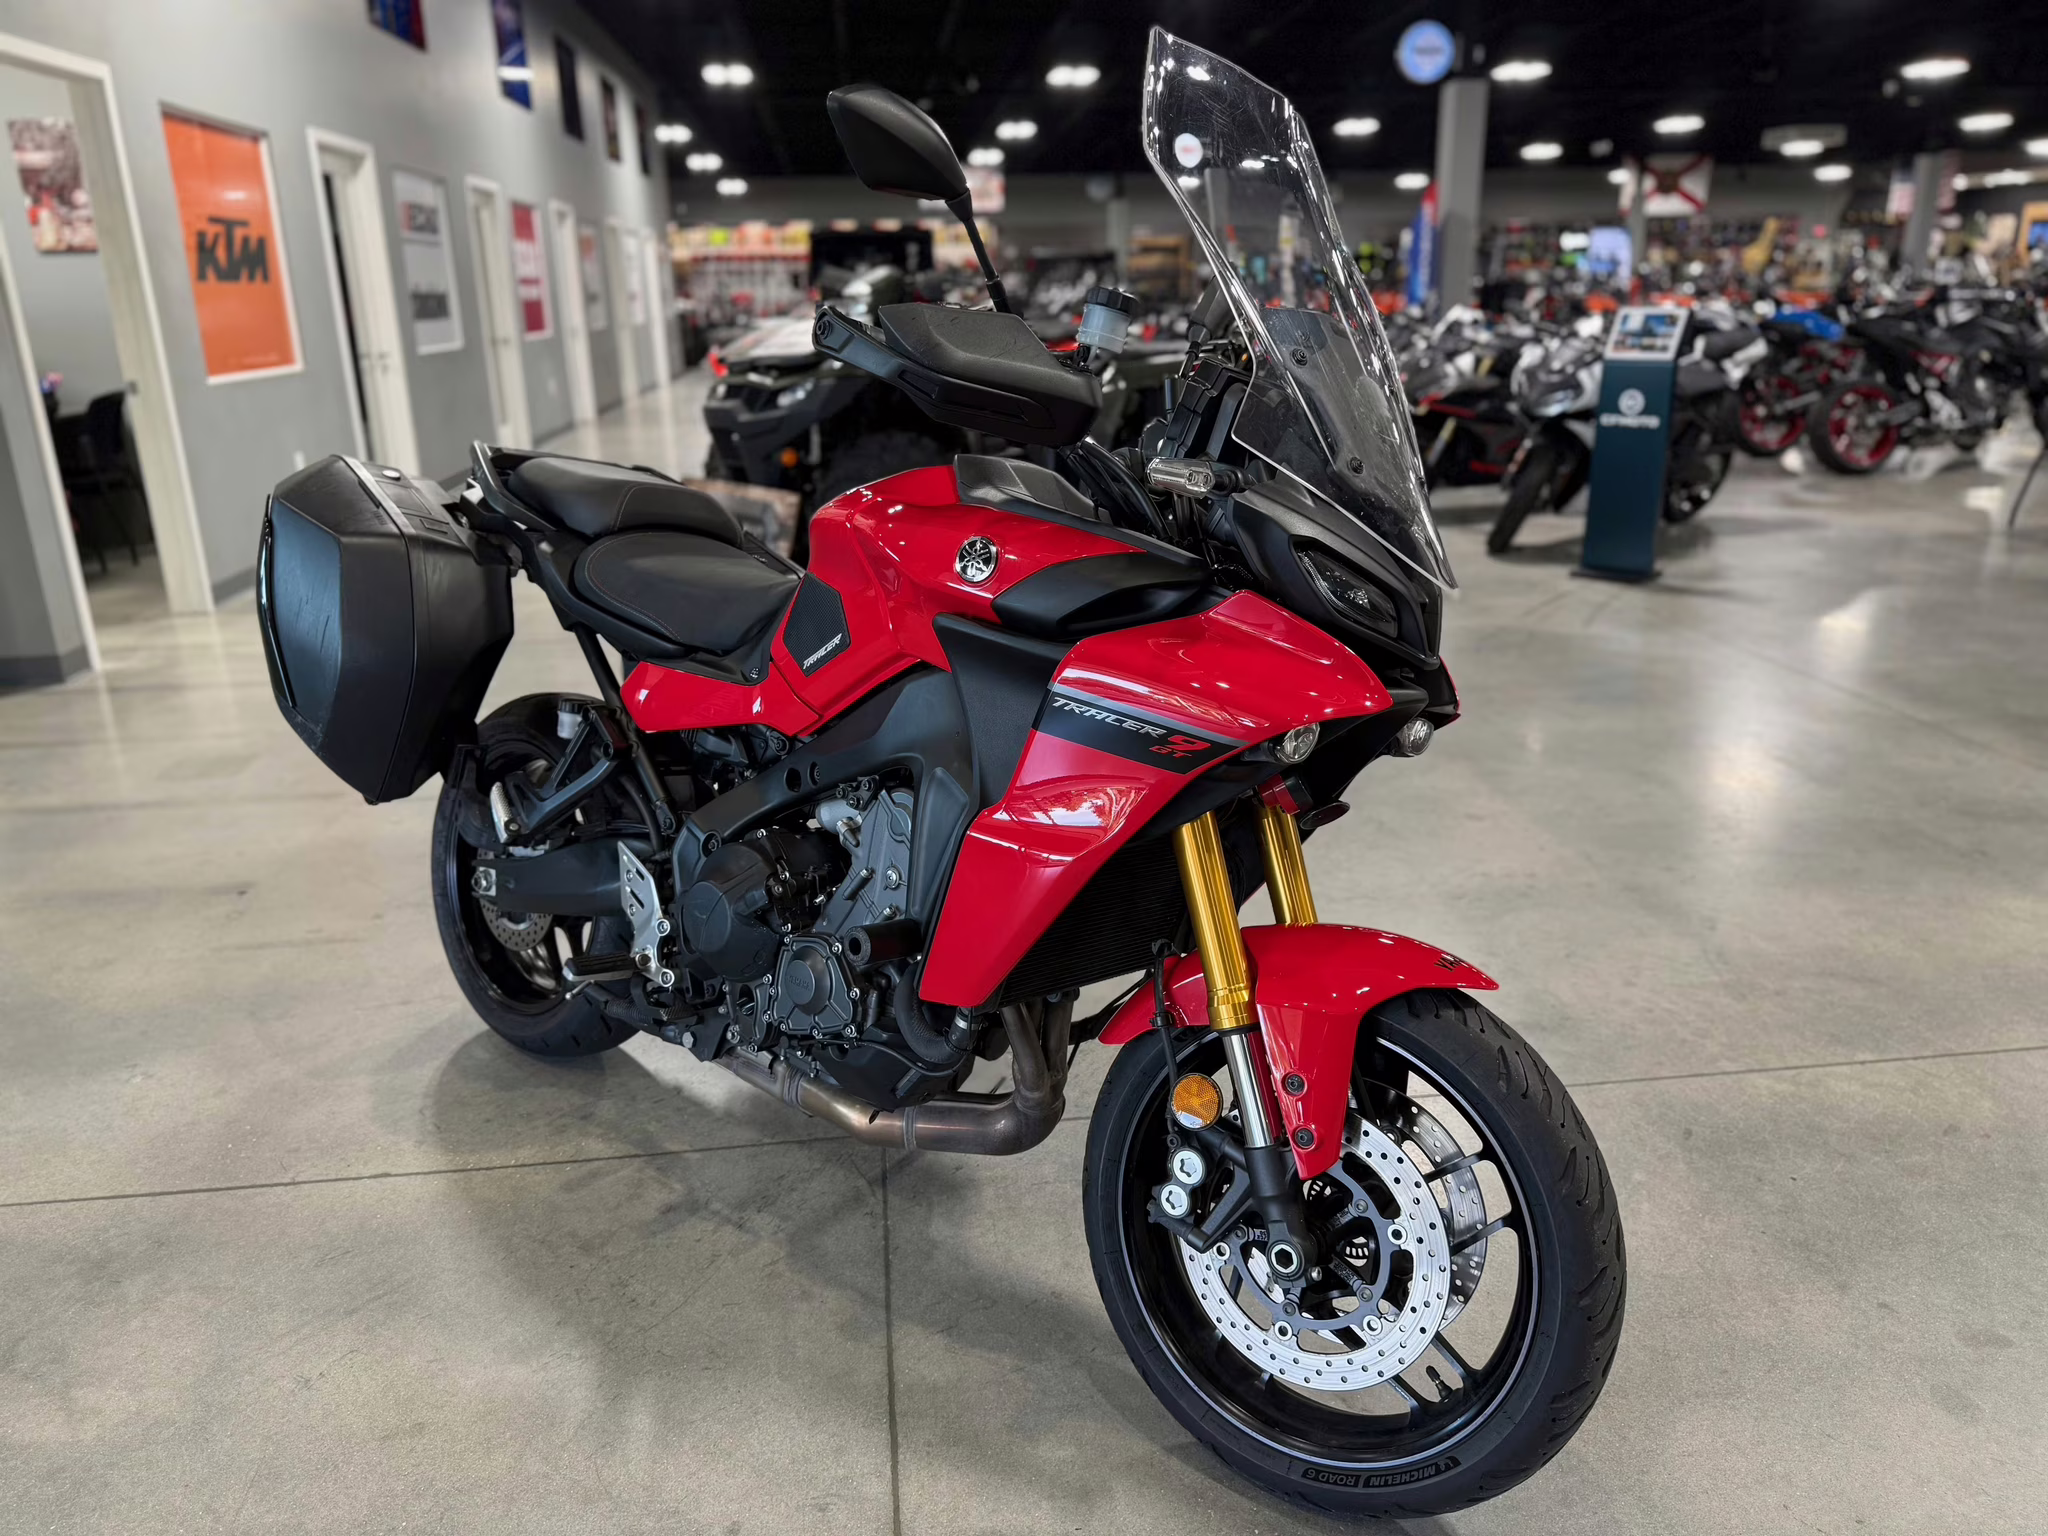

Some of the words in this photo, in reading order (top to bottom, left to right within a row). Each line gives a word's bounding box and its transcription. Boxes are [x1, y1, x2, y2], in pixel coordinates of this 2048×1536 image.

[197, 214, 269, 282] KTM
[803, 633, 842, 669] TRACER
[1052, 697, 1167, 738] TRACER
[1168, 734, 1211, 751] 9
[1149, 745, 1192, 758] GT
[1306, 1468, 1316, 1478] 6
[1318, 1471, 1356, 1486] ROAD
[1369, 1464, 1436, 1487] MICHELIN
